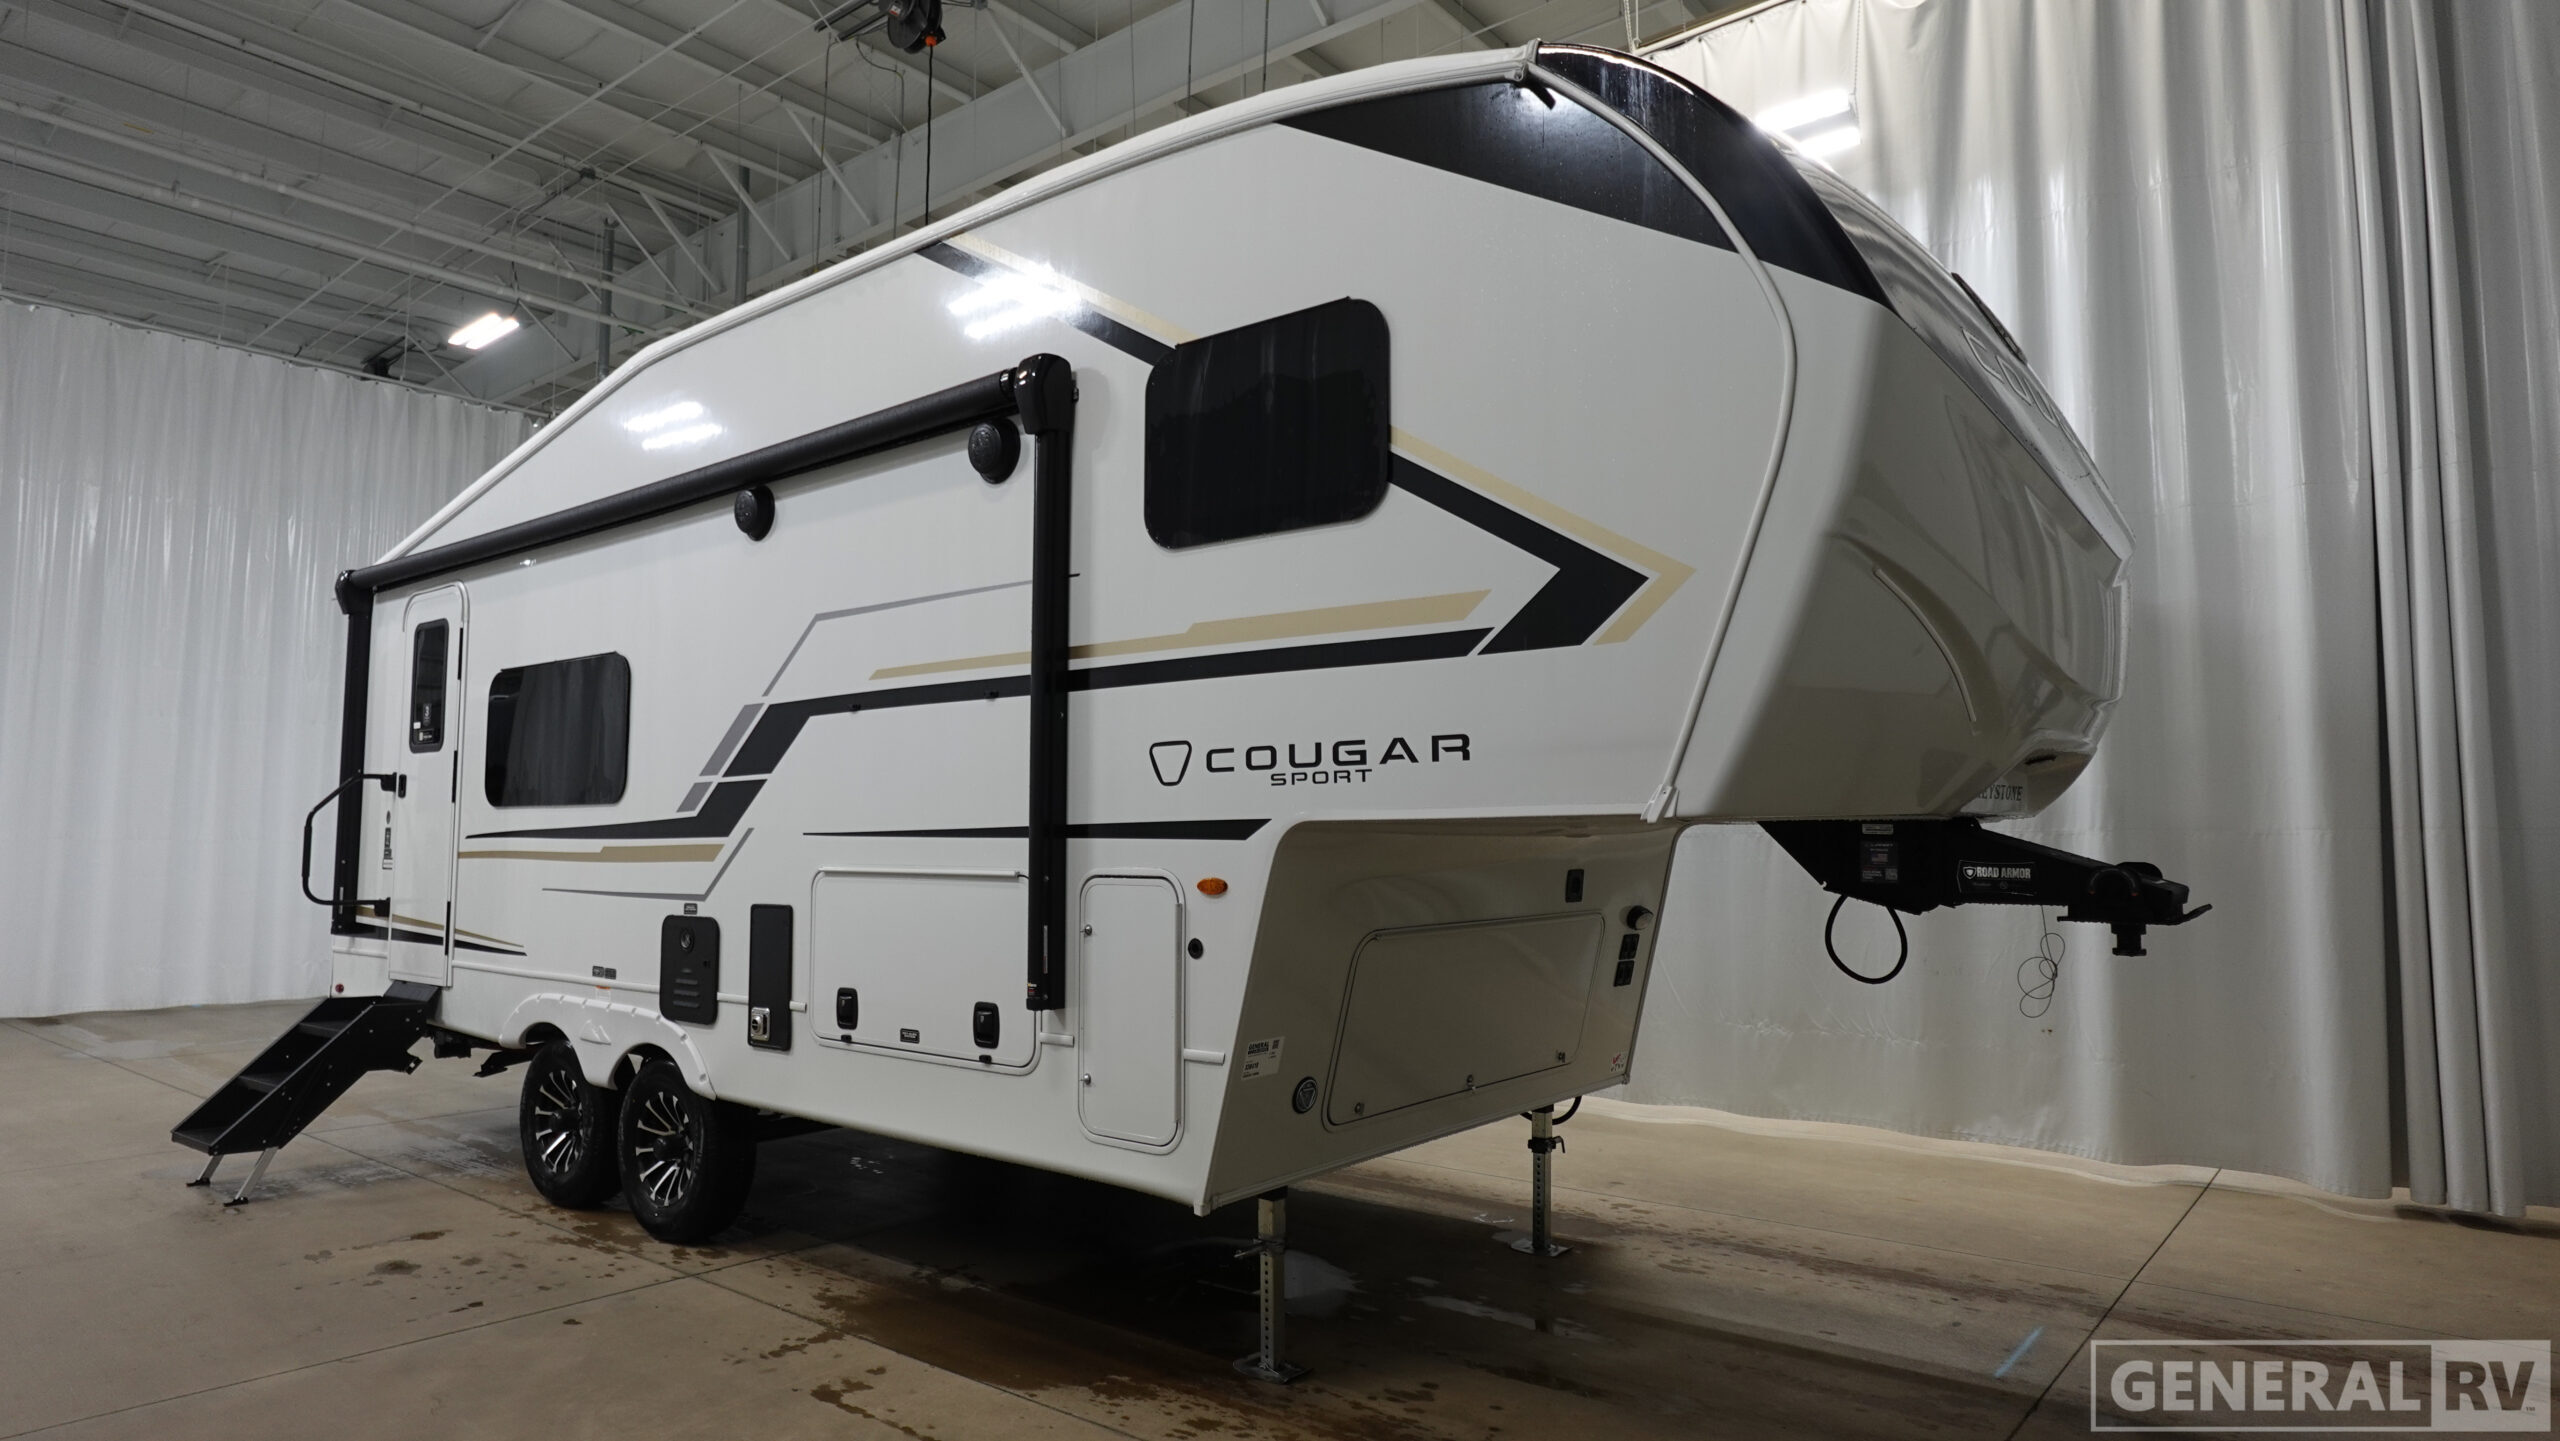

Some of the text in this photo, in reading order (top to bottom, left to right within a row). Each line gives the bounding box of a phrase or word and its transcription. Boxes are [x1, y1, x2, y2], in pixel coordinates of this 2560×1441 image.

[1205, 733, 1471, 773] COUGAR
[1270, 768, 1373, 786] SPORT
[1976, 866, 2031, 879] ROAD ARMOR
